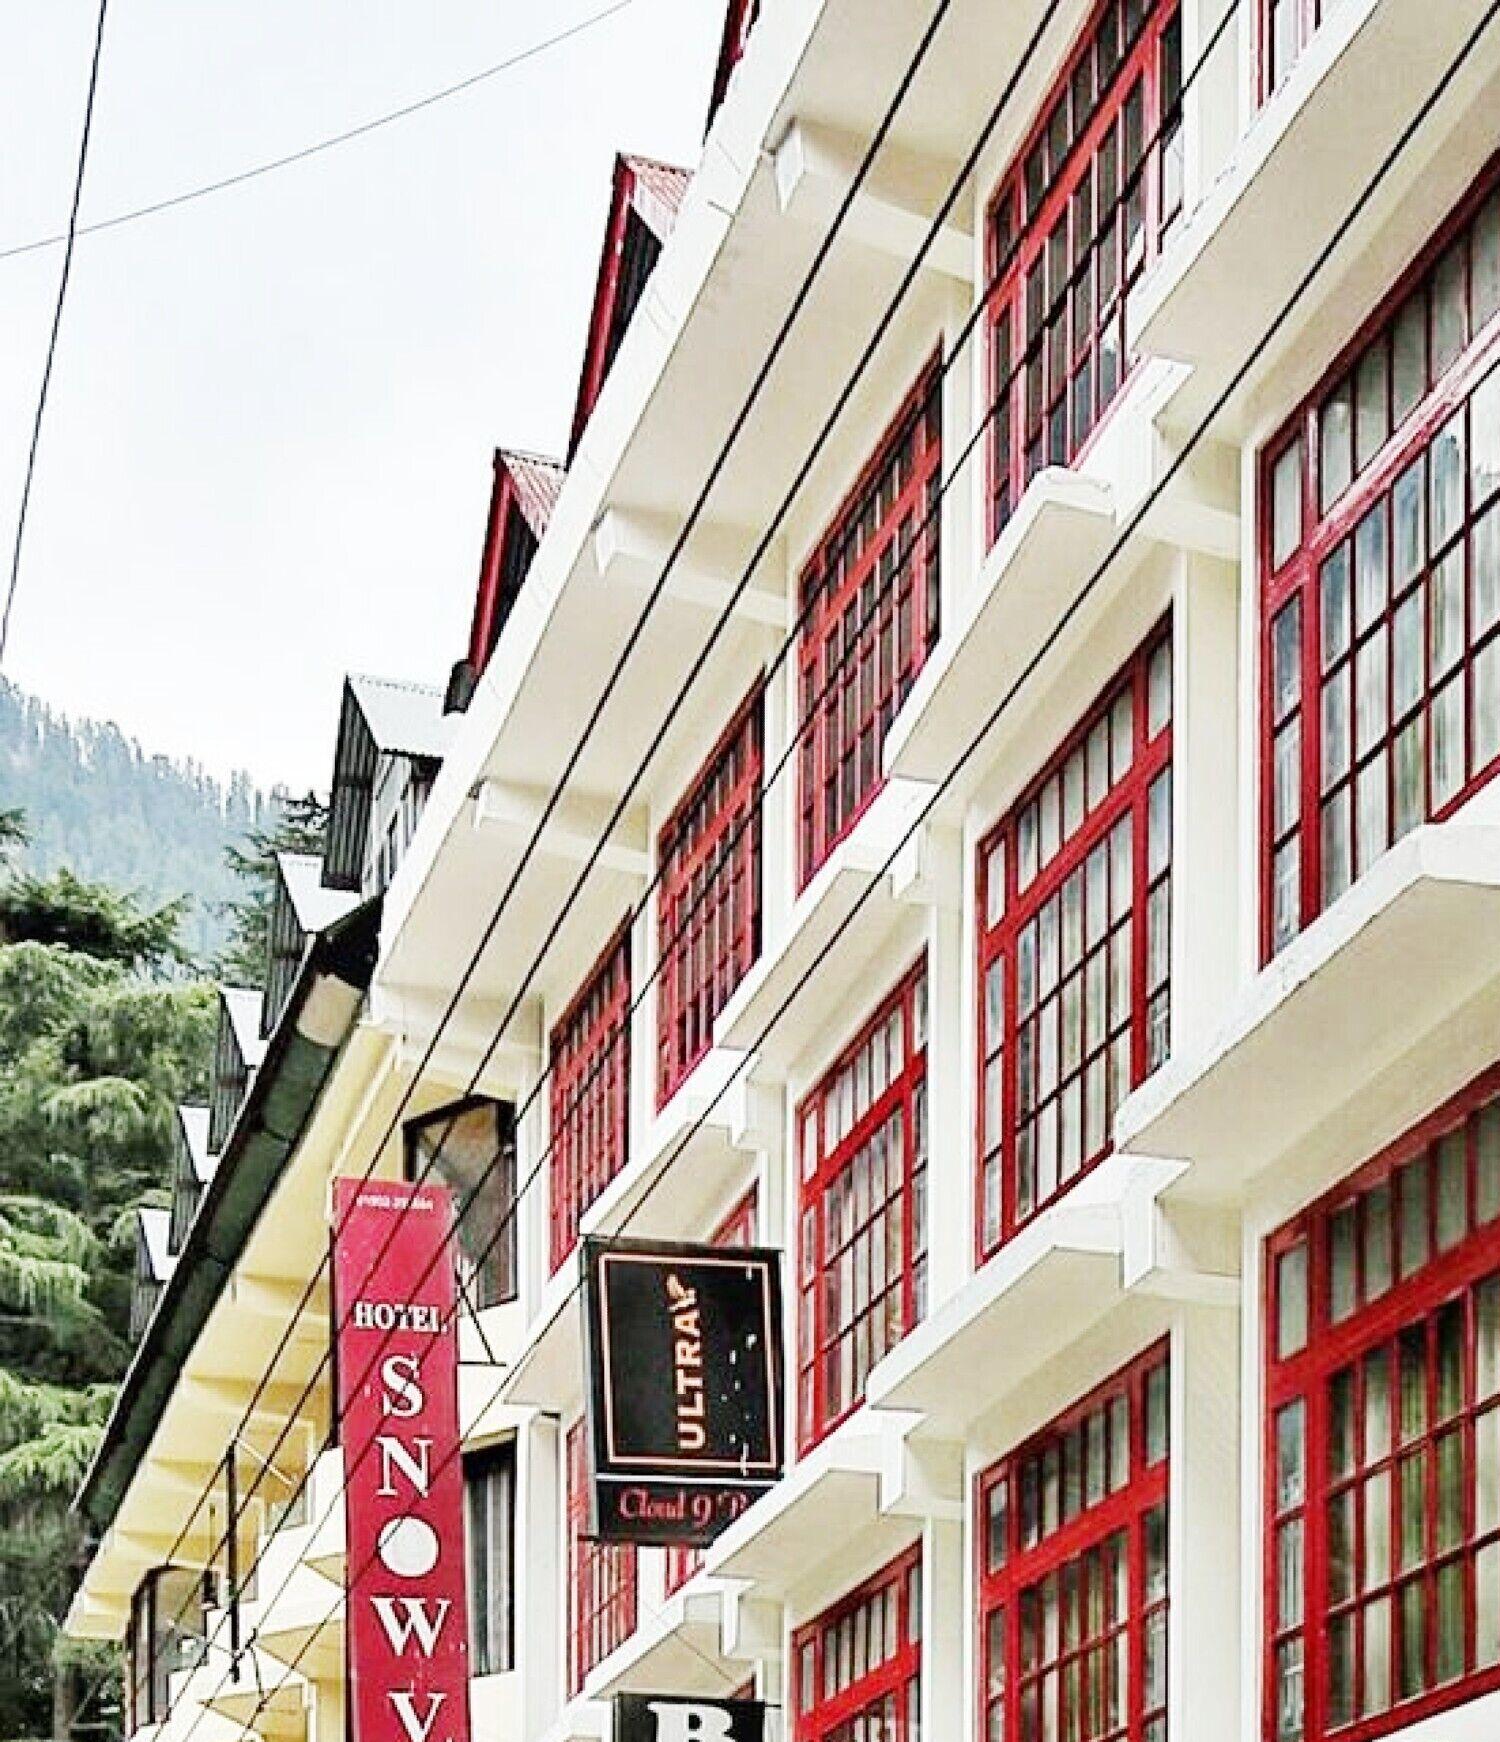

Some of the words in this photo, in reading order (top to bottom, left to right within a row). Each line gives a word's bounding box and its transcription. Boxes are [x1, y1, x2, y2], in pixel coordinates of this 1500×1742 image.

[354, 1300, 441, 1332] HOTEL
[618, 1486, 686, 1521] Cloud
[692, 1492, 713, 1528] 9
